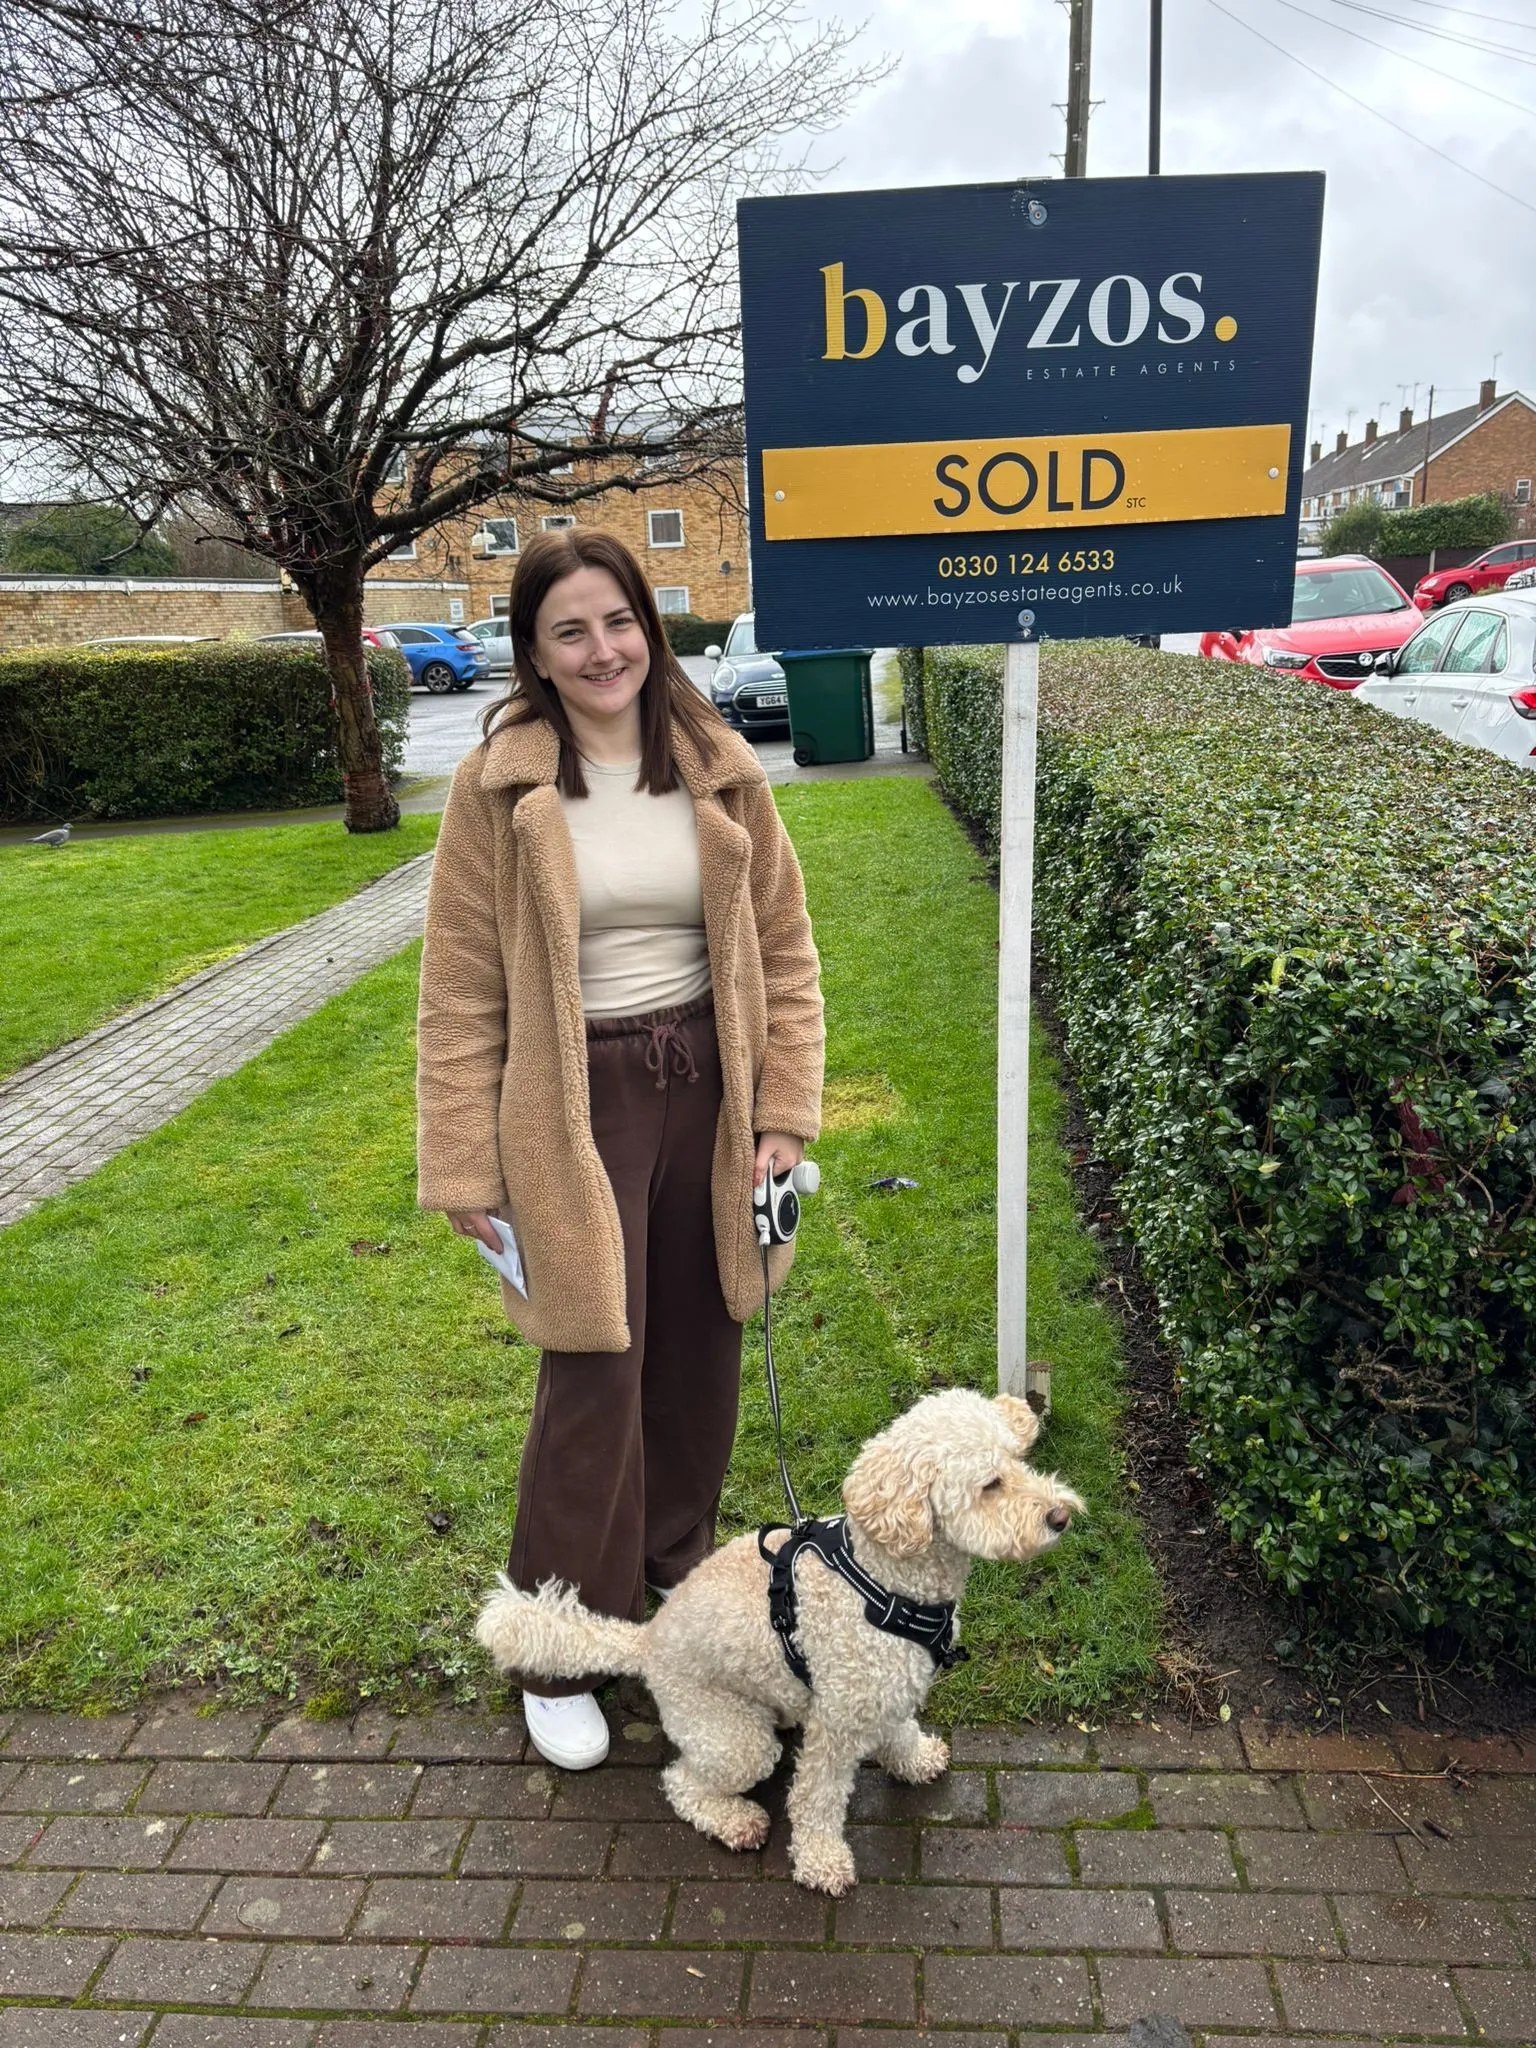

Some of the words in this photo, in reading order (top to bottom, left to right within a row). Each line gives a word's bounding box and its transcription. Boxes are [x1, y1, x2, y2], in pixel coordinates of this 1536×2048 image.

[819, 261, 1238, 384] bayzos.
[1026, 365, 1117, 380] ESTATE
[1140, 359, 1236, 375] AGENTS
[933, 448, 1126, 518] SOLD
[1126, 496, 1147, 509] STC
[938, 555, 998, 578] 0330
[1008, 552, 1050, 575] 124
[1058, 549, 1115, 573] 6533
[867, 573, 1183, 610] www.bayzosestateagents.co.uk
